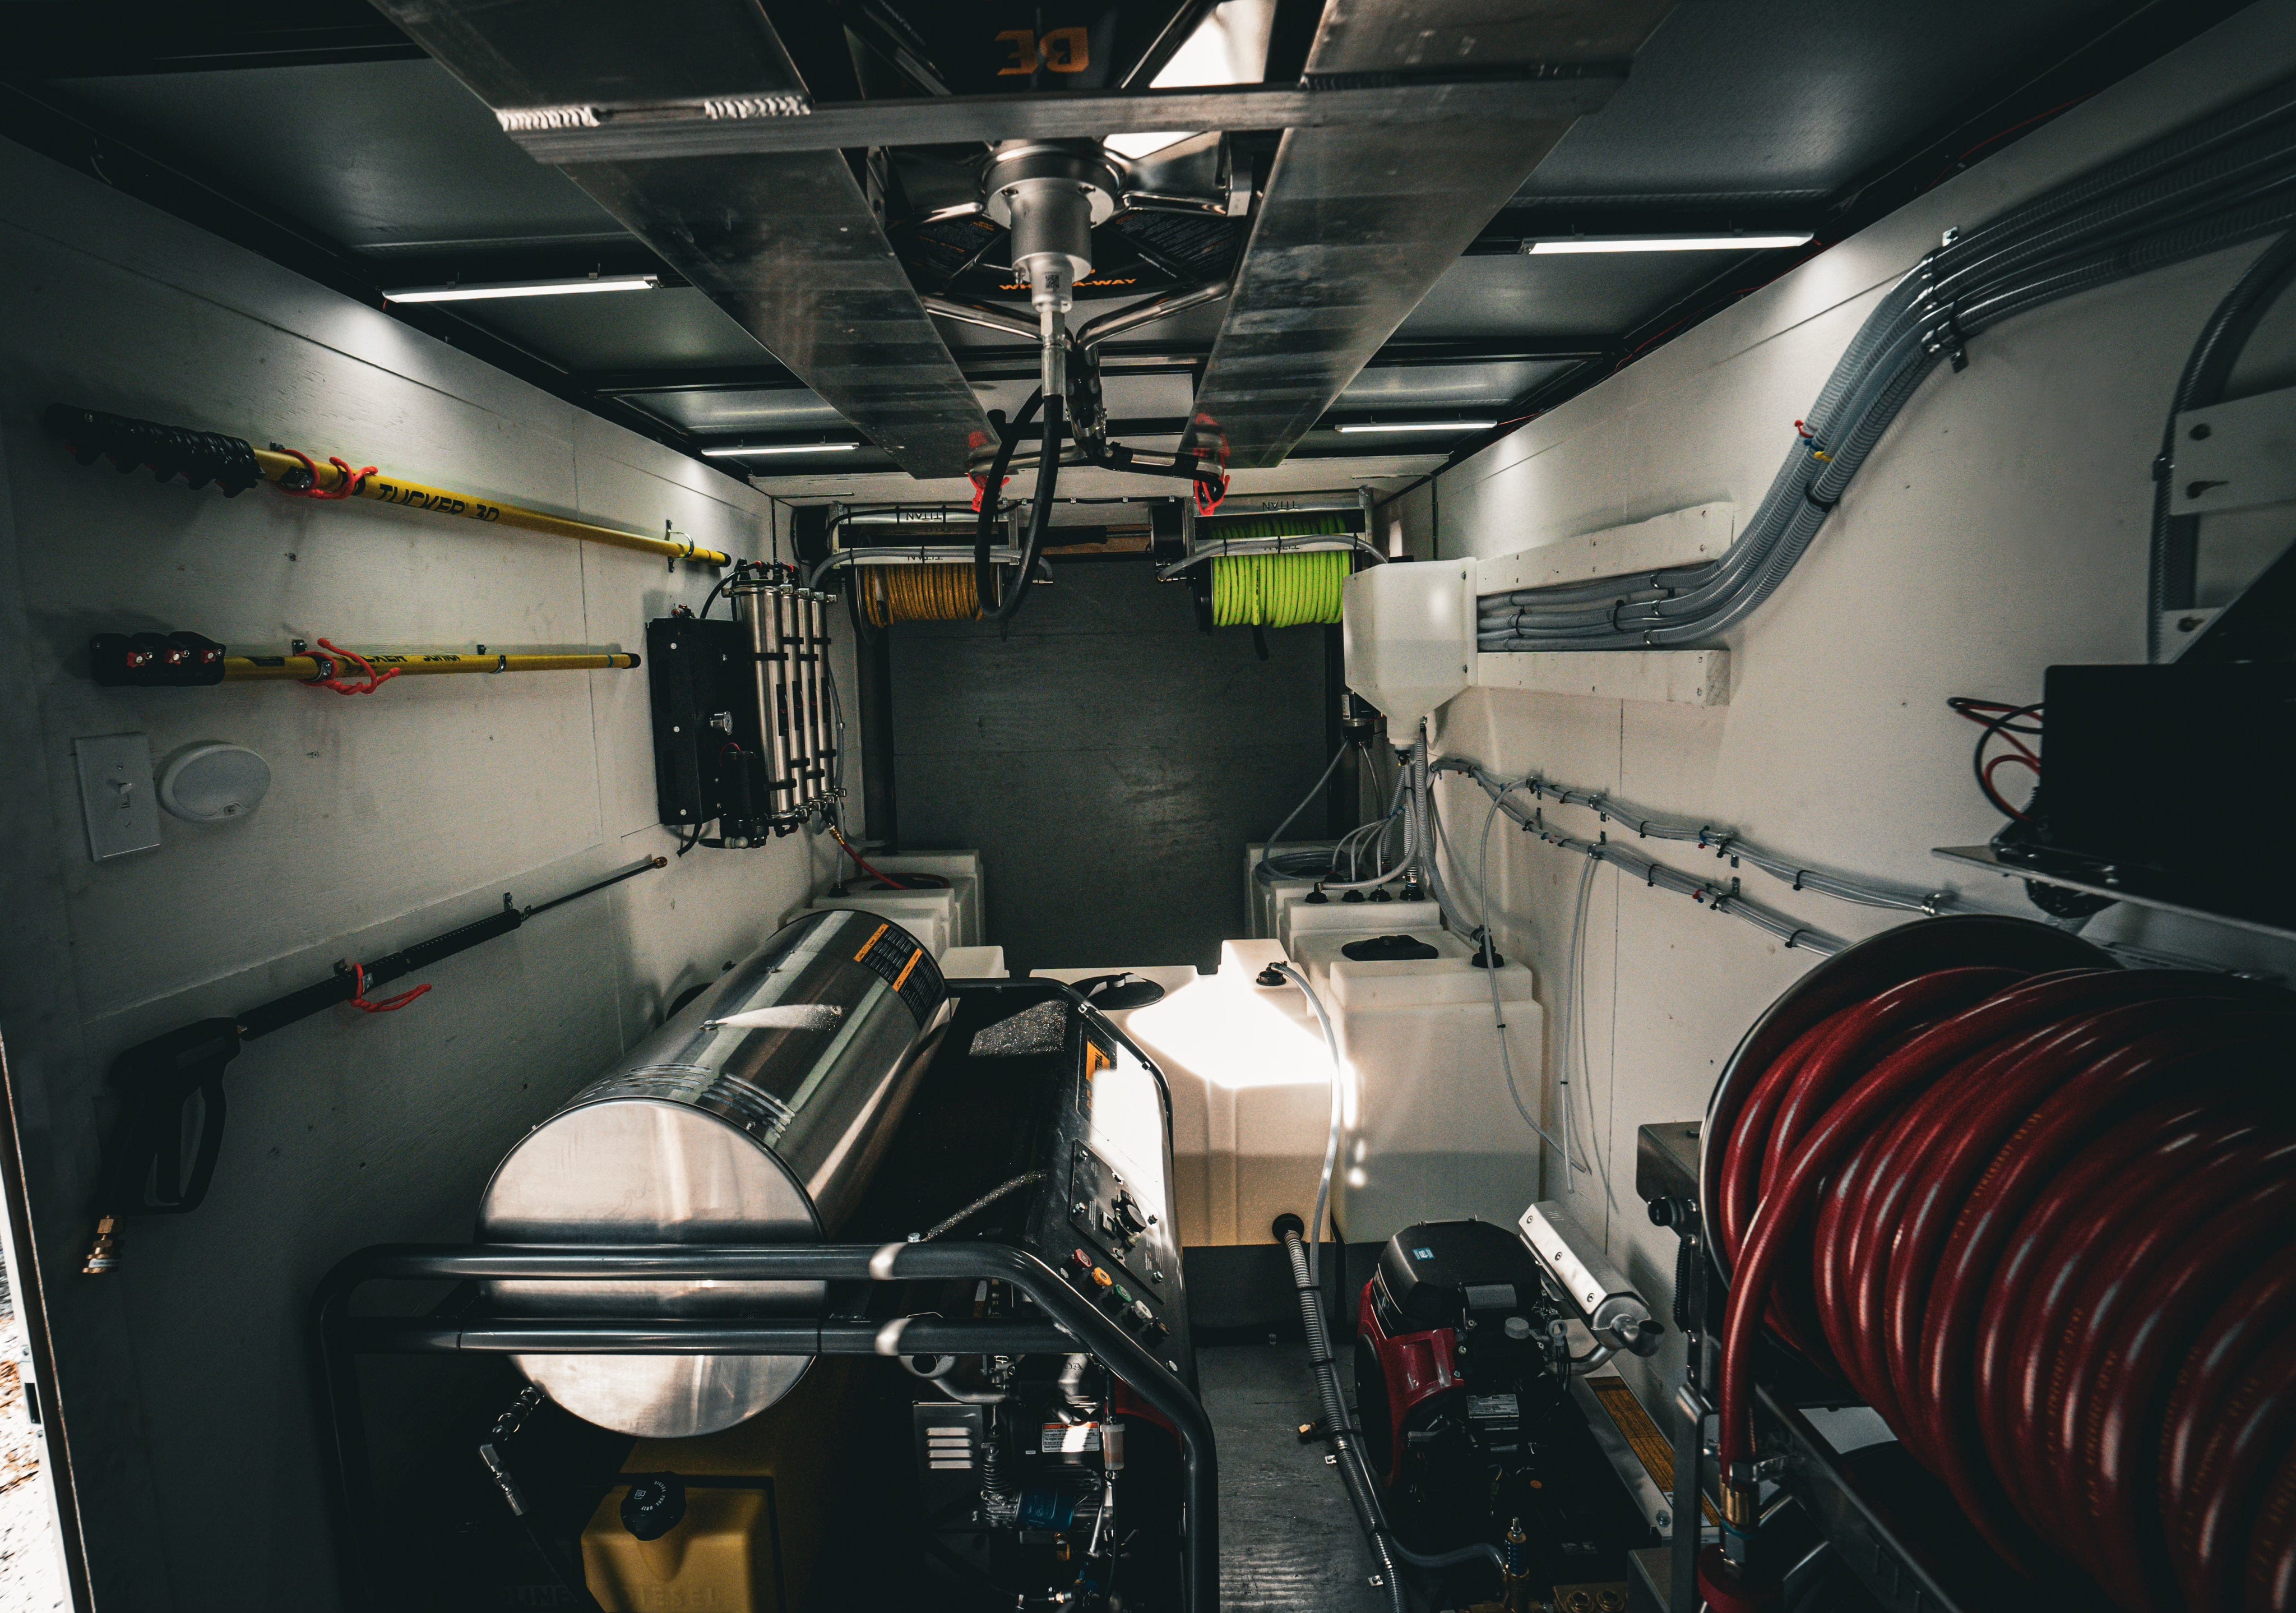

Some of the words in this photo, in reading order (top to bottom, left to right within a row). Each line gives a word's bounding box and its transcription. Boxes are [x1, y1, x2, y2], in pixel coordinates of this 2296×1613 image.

[994, 27, 1090, 77] BE
[999, 278, 1137, 290] WHA-WAY
[376, 483, 465, 515] TUCKER
[1262, 500, 1299, 511] TITAN
[906, 511, 942, 520] TITAN
